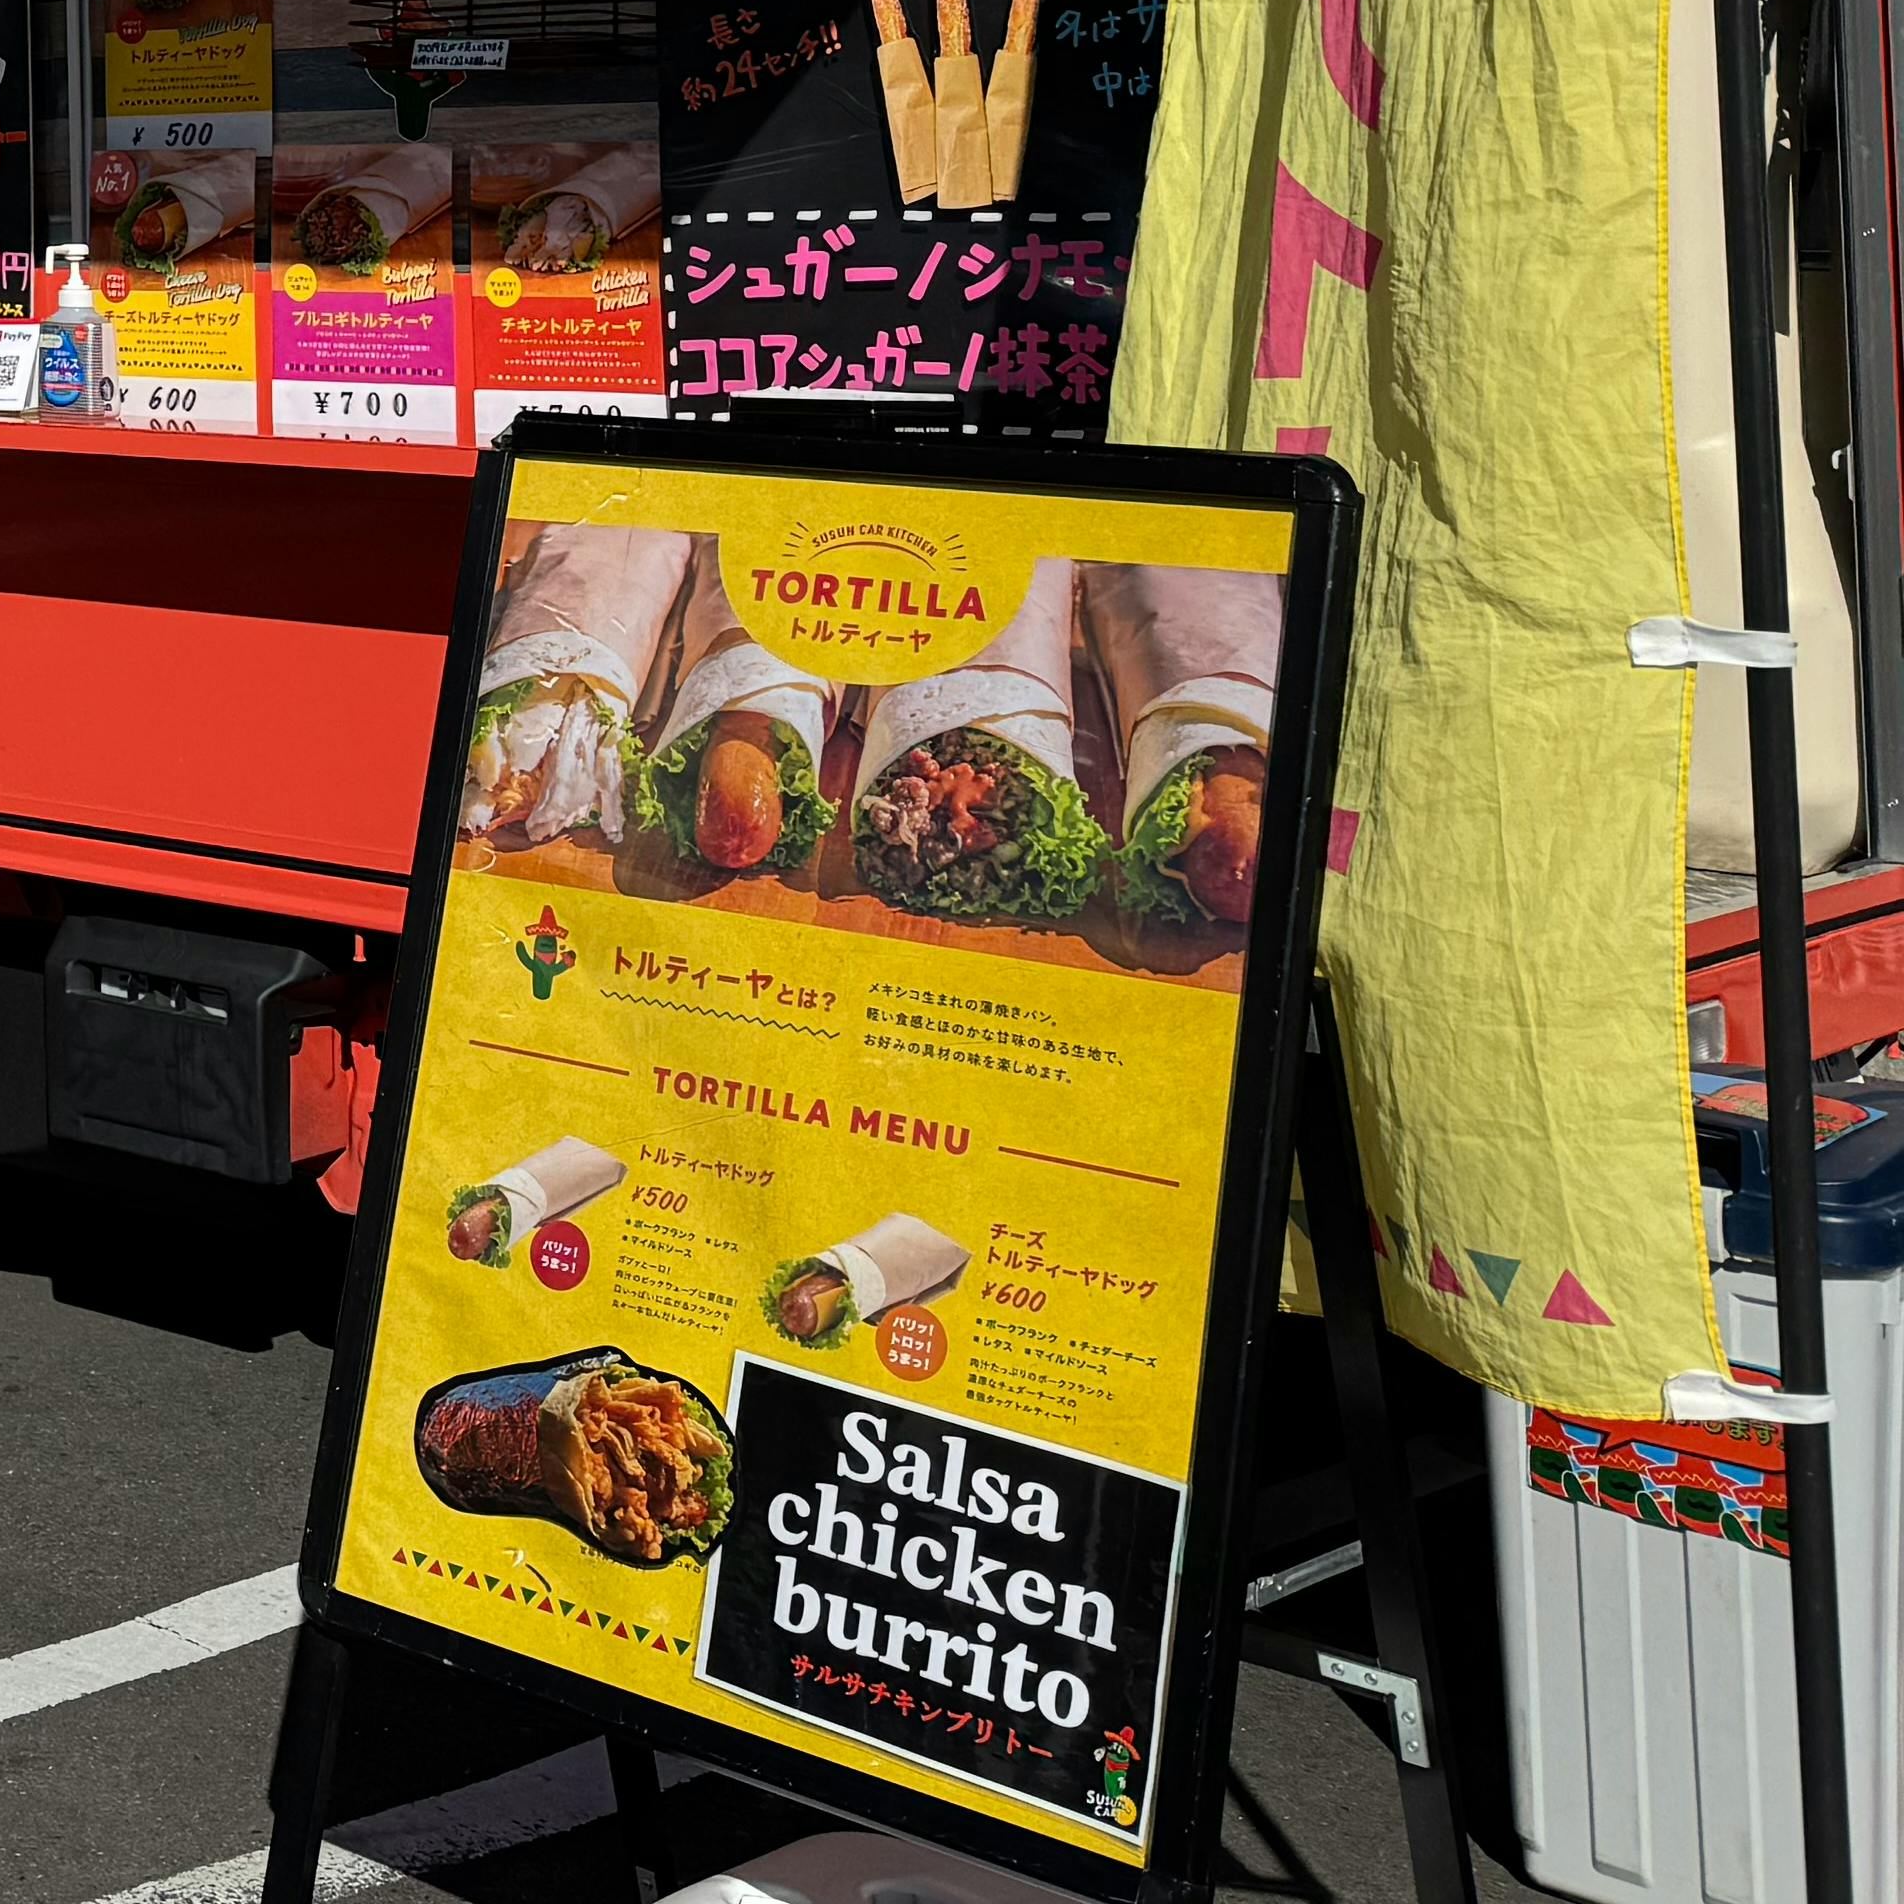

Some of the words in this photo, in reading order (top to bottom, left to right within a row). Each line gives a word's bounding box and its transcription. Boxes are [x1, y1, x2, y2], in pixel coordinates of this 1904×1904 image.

[705, 7, 762, 50] 長さ
[130, 43, 247, 64] トルティーヤドッグ
[591, 266, 649, 293] Chicken
[685, 223, 1132, 304] シュガー/シナモ
[291, 310, 434, 331] ブルコギトルティーヤ
[594, 287, 650, 314] Tortilla
[500, 316, 643, 337] チキントルティーヤ
[149, 385, 198, 413] 600
[811, 524, 856, 548] SUSUN
[858, 523, 884, 537] CAR
[886, 525, 940, 558] KITCHEN
[750, 568, 987, 622] TORTILLA
[791, 616, 933, 654] トルティーヤ
[613, 945, 838, 1013] トルティーヤとは?
[652, 1066, 831, 1128] TORTILLA
[848, 1105, 973, 1157] MENU
[638, 1143, 776, 1188] トルティーヤドッグ
[630, 1184, 690, 1215] ¥500
[989, 1222, 1048, 1251] チーズ
[986, 1245, 1160, 1300] トルティーヤドッグ
[980, 1281, 1048, 1314] ¥600
[835, 1408, 1065, 1544] Salsa
[766, 1481, 1117, 1653] chicken
[772, 1554, 1093, 1730] burrito
[788, 1651, 1055, 1762] サルサチキンブリトー
